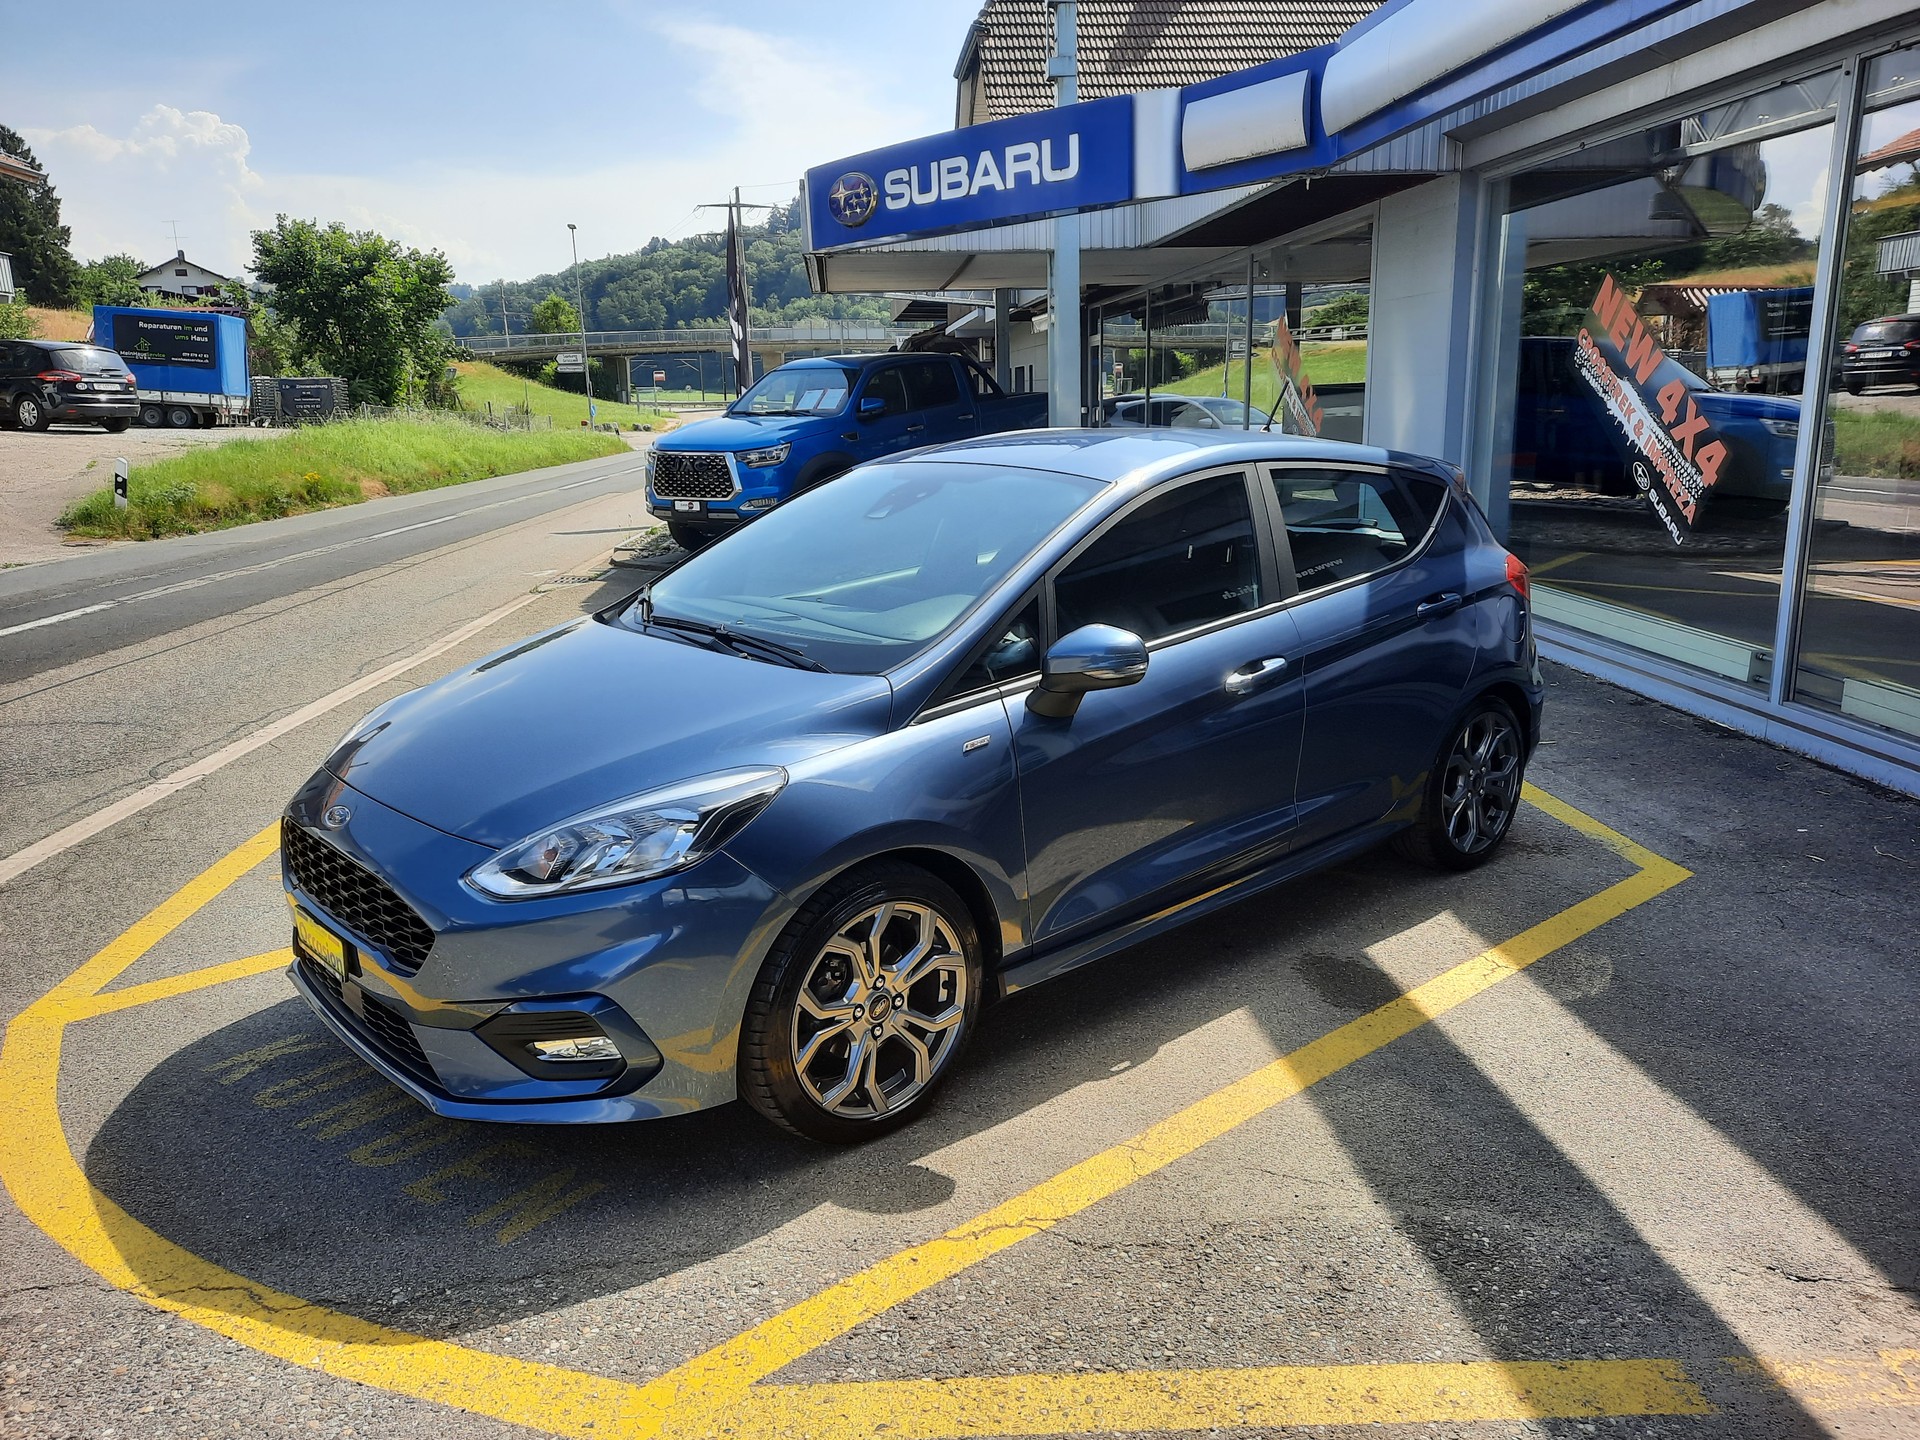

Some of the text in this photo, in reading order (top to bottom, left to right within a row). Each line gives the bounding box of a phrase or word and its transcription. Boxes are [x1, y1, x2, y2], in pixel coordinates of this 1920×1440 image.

[884, 133, 1080, 210] SUBARU
[139, 321, 182, 331] Reparaturen
[1591, 273, 1728, 488] NEW 4X4
[1578, 327, 1697, 526] CROSSTREK & IMPREZA
[1648, 488, 1683, 546] SUBARU
[298, 921, 344, 975] Occasion
